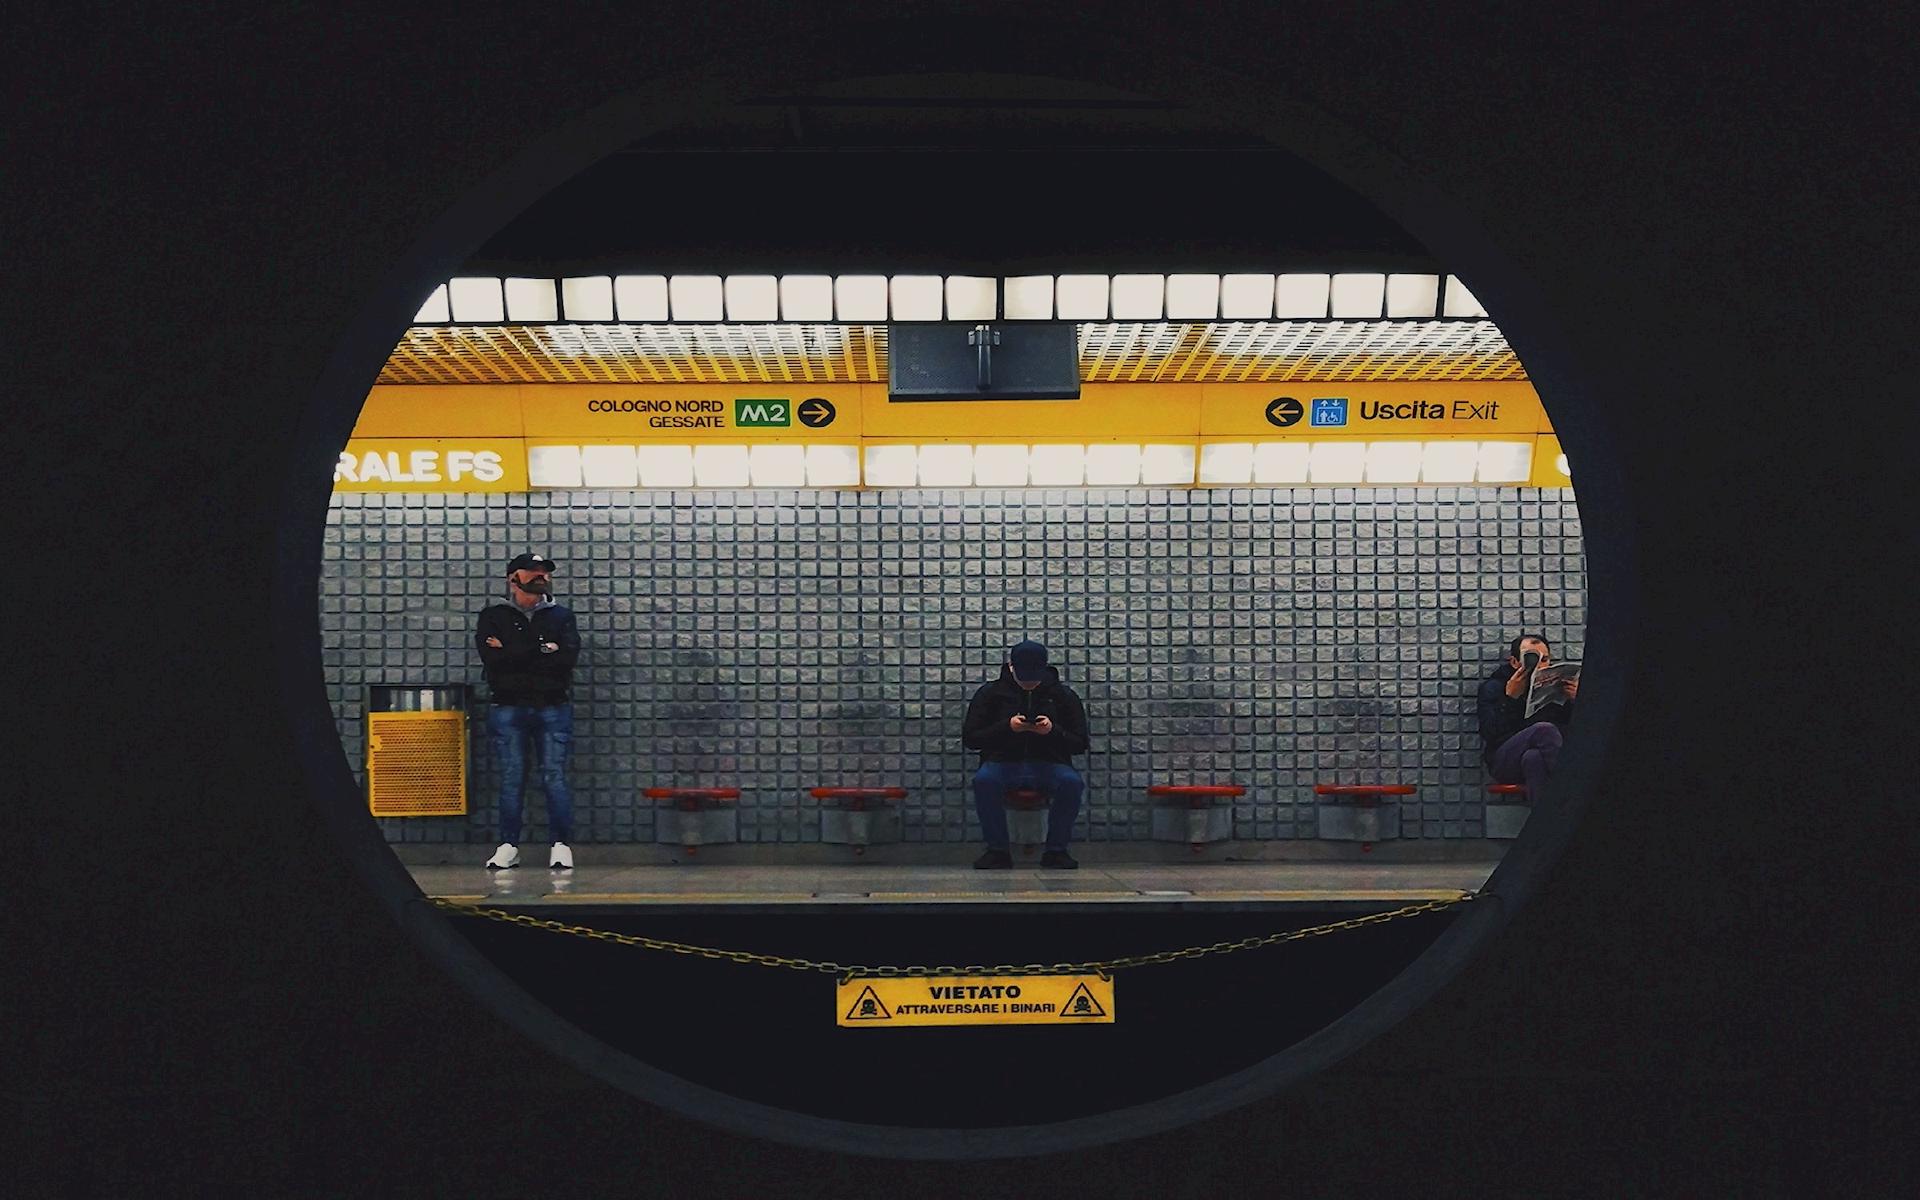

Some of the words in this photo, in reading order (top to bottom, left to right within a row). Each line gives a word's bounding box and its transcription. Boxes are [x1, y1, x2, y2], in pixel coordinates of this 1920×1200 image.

[588, 400, 672, 412] COLOGNO
[675, 400, 724, 412] NORD
[740, 404, 786, 422] M2
[1360, 400, 1445, 420] Uscita
[1452, 400, 1499, 420] Exit
[649, 416, 725, 428] GESSATE
[447, 451, 504, 482] FS
[929, 985, 1021, 999] VIETATO
[896, 1003, 999, 1015] ATTRAVERSARE
[1011, 1003, 1056, 1014] BINARI
